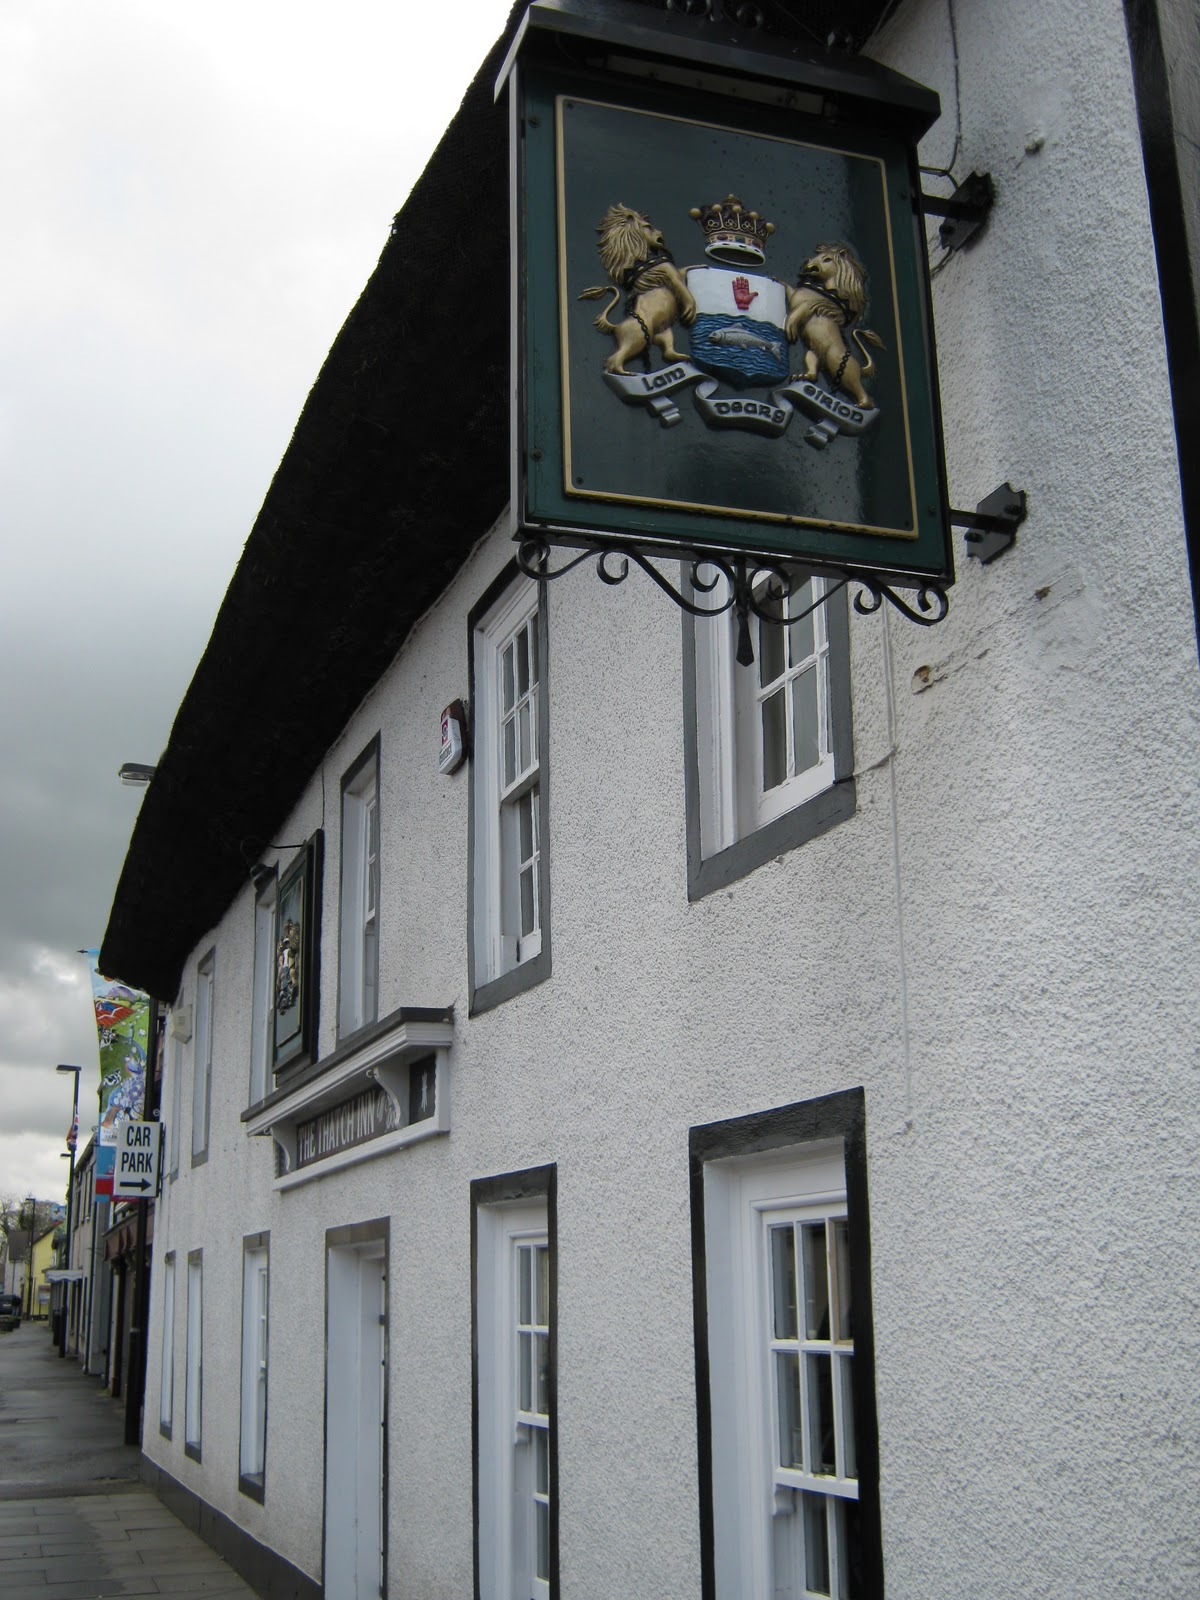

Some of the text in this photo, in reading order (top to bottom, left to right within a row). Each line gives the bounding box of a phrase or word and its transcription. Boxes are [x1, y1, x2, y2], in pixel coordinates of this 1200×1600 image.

[126, 1125, 151, 1147] CAR
[299, 1090, 375, 1162] THE THATCH INN
[121, 1151, 153, 1173] PARK
